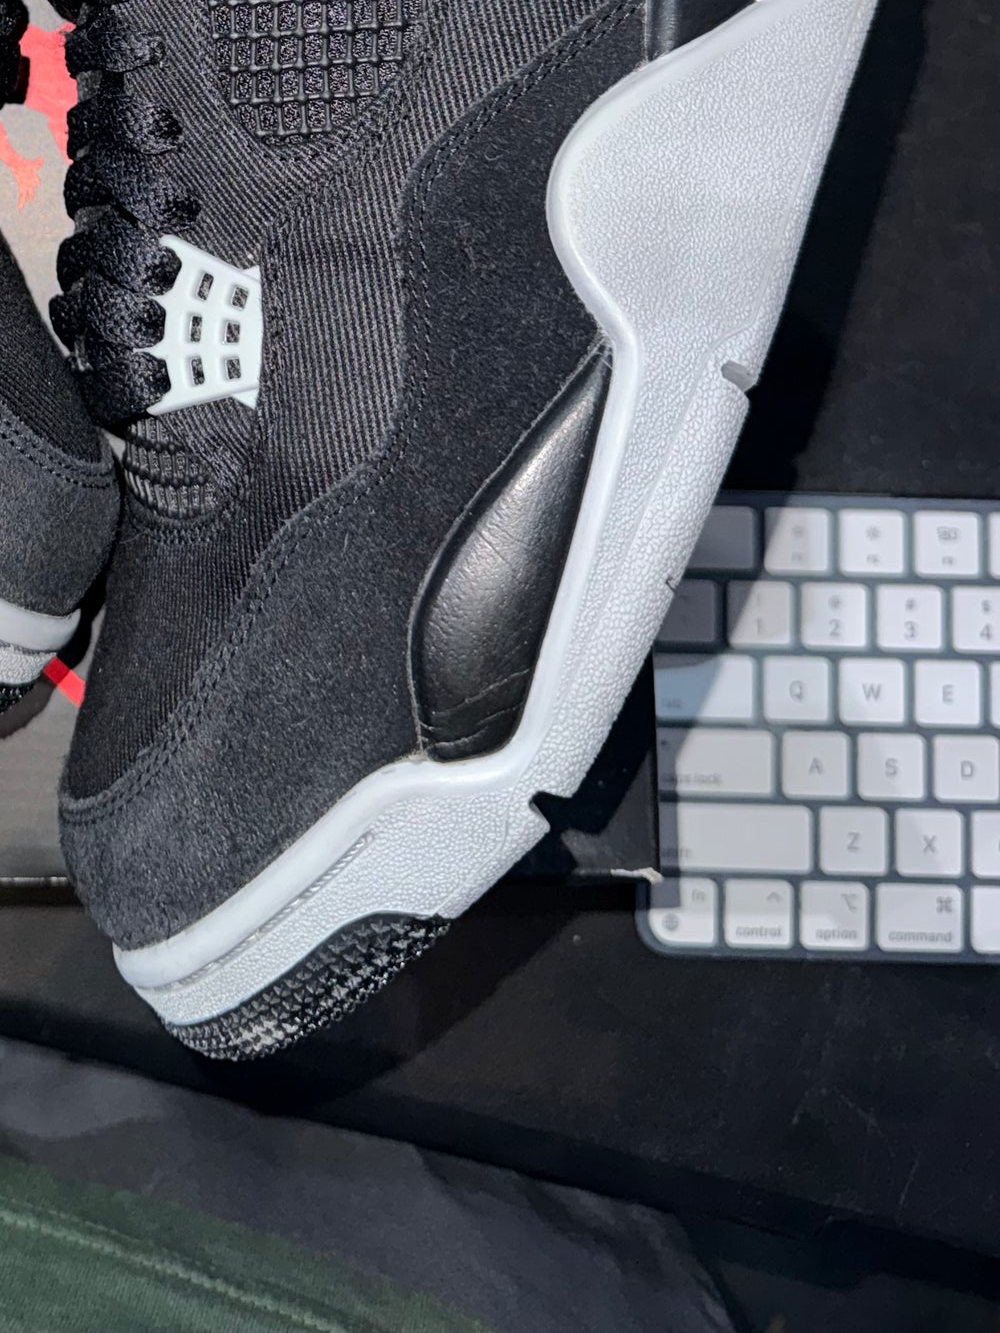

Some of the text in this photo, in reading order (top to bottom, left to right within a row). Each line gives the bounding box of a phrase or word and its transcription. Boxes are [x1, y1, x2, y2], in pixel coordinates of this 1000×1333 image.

[828, 619, 842, 637] 2
[904, 621, 918, 639] 3
[979, 623, 993, 641] 4
[789, 680, 804, 701] Q
[862, 683, 882, 701] W
[942, 684, 954, 703] E
[808, 757, 823, 776] A
[884, 758, 898, 777] S
[961, 760, 975, 780] D
[847, 832, 860, 851] Z
[923, 835, 936, 854] X
[735, 925, 781, 938] control
[815, 928, 857, 941] option
[888, 929, 953, 943] command
